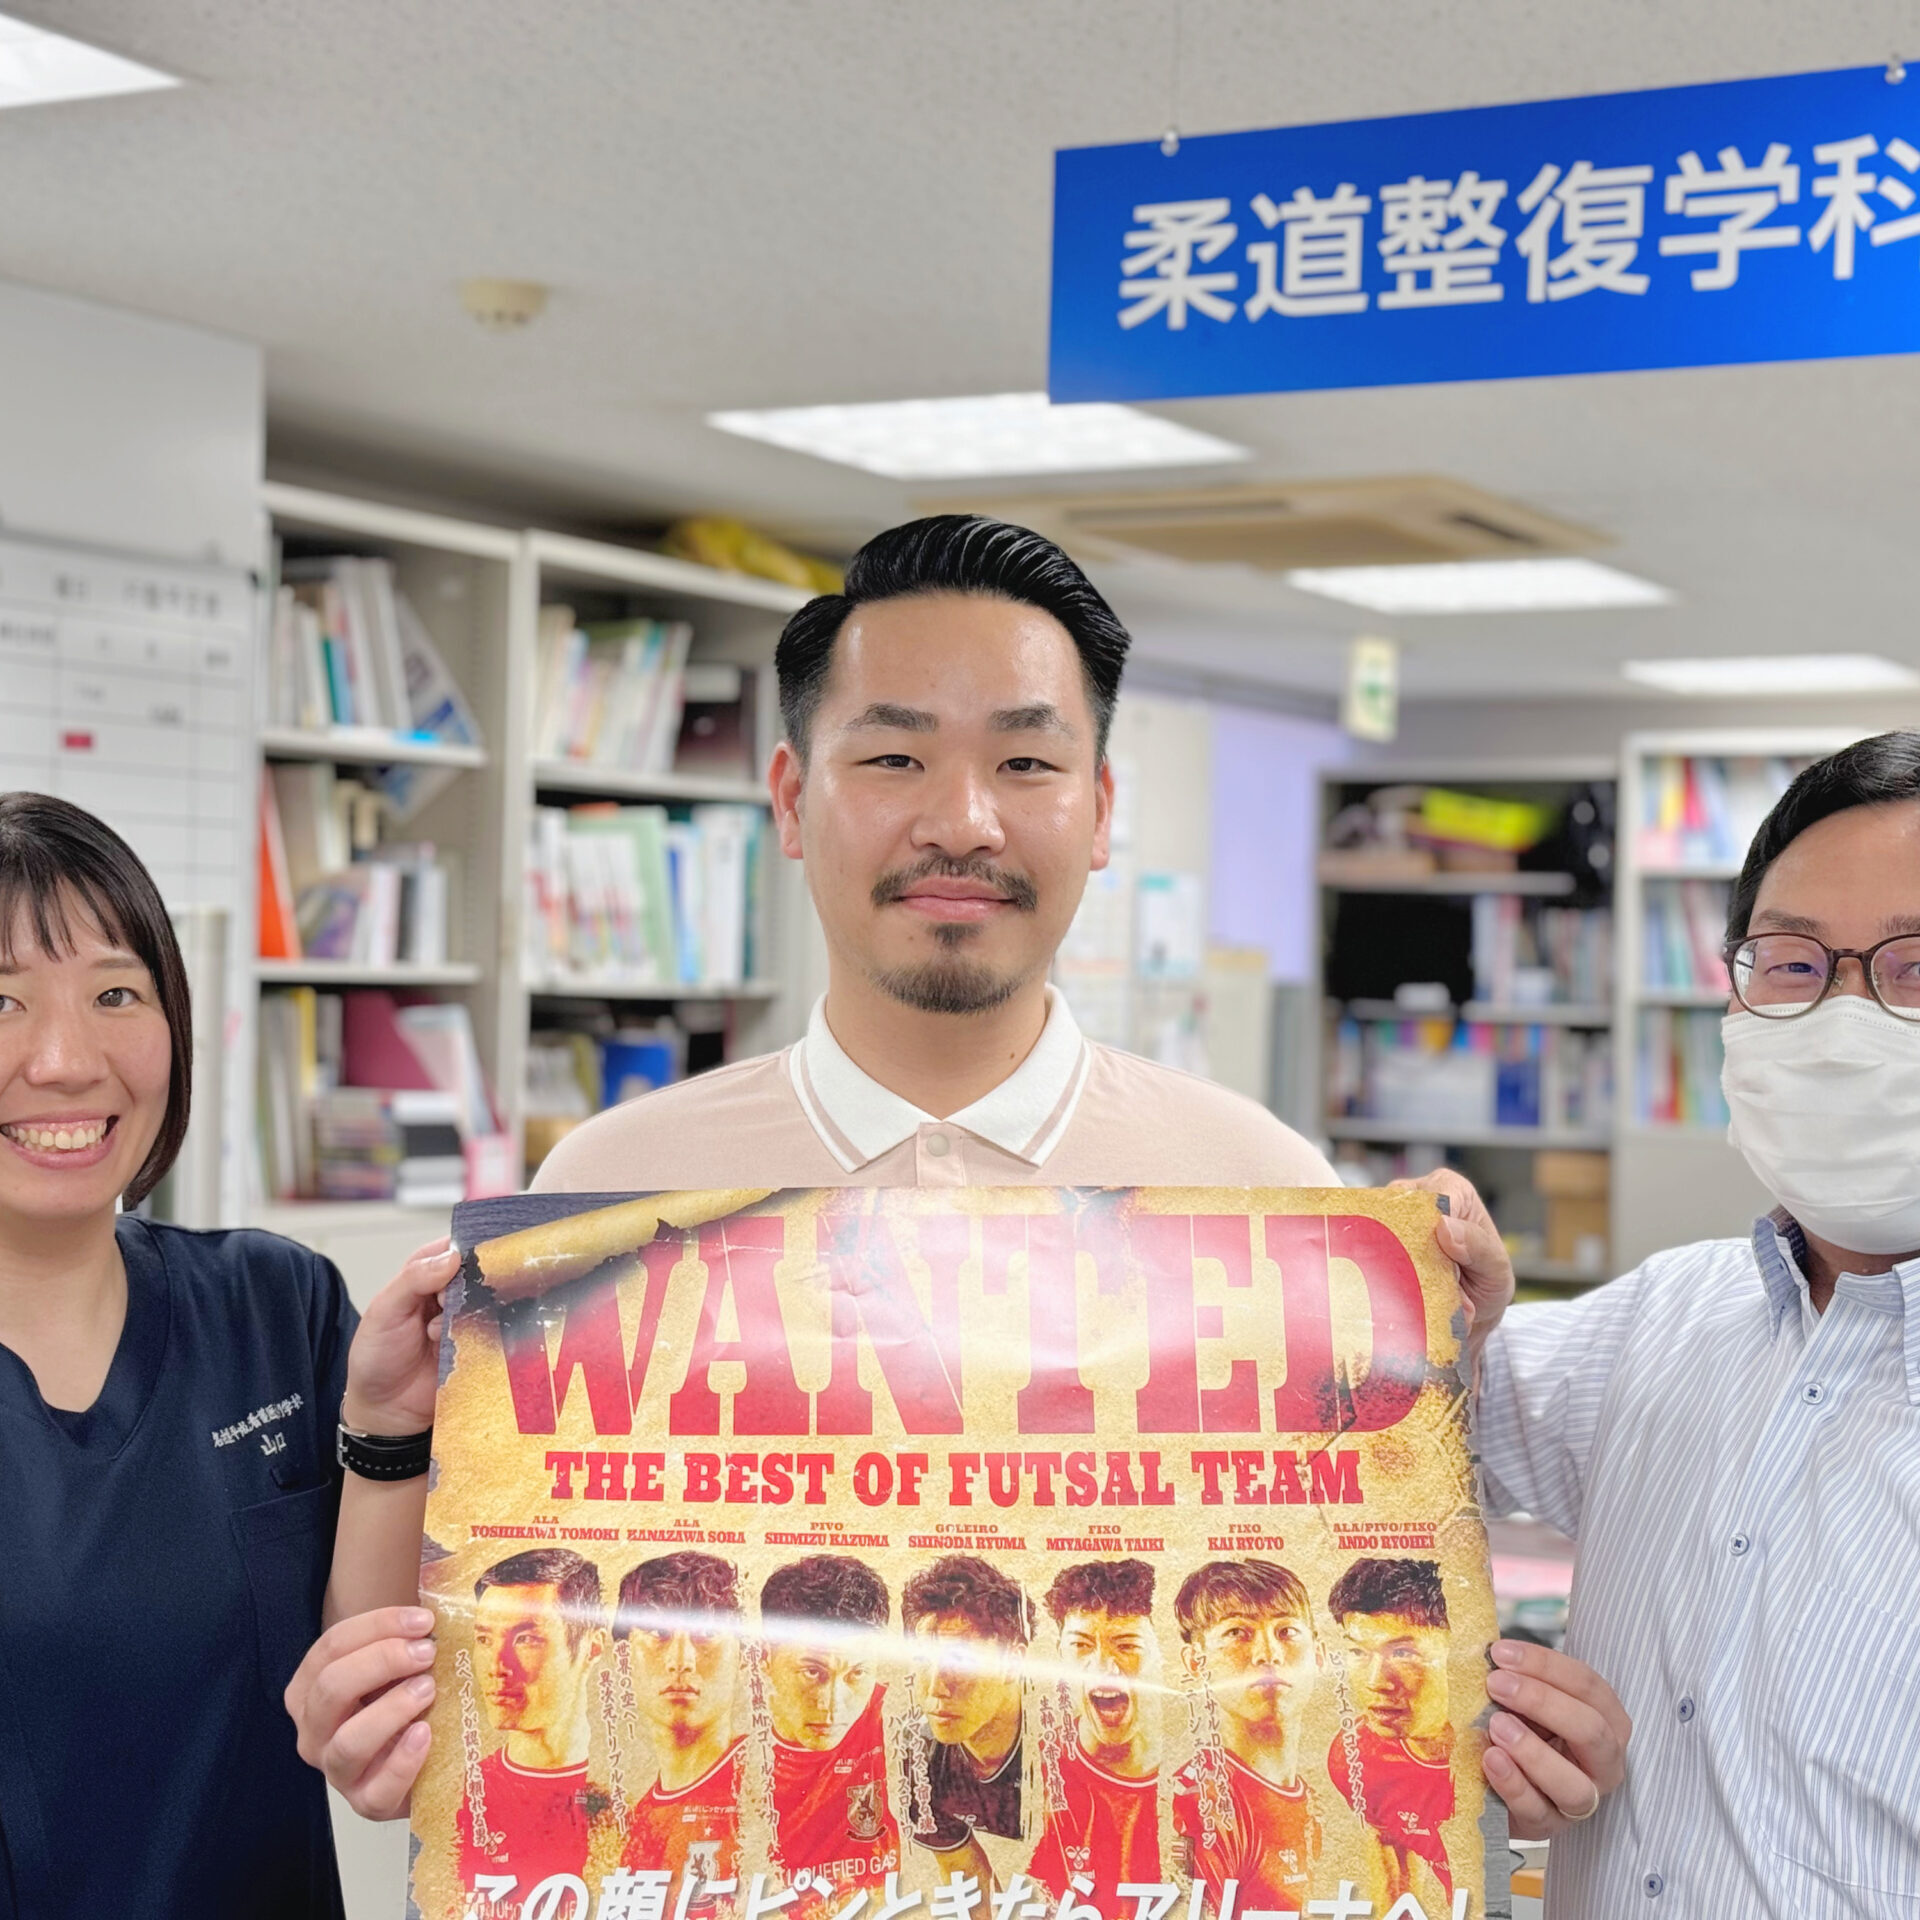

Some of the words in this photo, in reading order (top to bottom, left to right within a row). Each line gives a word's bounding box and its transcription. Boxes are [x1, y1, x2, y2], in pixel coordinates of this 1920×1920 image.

[1117, 134, 1920, 331] 柔道整復学科
[500, 1214, 1427, 1437] WANTED
[260, 1432, 287, 1456] 山口
[545, 1451, 666, 1500] THE
[683, 1453, 834, 1504] BEST
[853, 1452, 929, 1506] OF
[947, 1452, 1175, 1507] FUTSAL
[1191, 1450, 1364, 1505] TEAM
[532, 1515, 560, 1525] ALA
[673, 1519, 701, 1528] ALA
[810, 1522, 844, 1531] PIVO
[1333, 1522, 1438, 1533] ALA/PIVO/FIXO
[470, 1525, 557, 1539] YOSHIKAWA
[560, 1528, 620, 1541] TOMOKI
[626, 1529, 705, 1543] KANAZAWA
[708, 1532, 746, 1544] SORA
[1088, 1525, 1122, 1535] FIXO
[1228, 1524, 1262, 1534] FIXO
[764, 1532, 826, 1546] SHIMIZU
[908, 1535, 974, 1549] SHINODA
[976, 1536, 1027, 1550] RYUMA
[1046, 1537, 1123, 1552] MIYAGAWA
[1125, 1538, 1165, 1552] TAIKI
[1207, 1537, 1234, 1551] KAI
[1236, 1536, 1284, 1551] RYOTO
[1338, 1536, 1378, 1550] ANDO
[1381, 1535, 1436, 1549] RYOHEI
[869, 1848, 897, 1875] GAS
